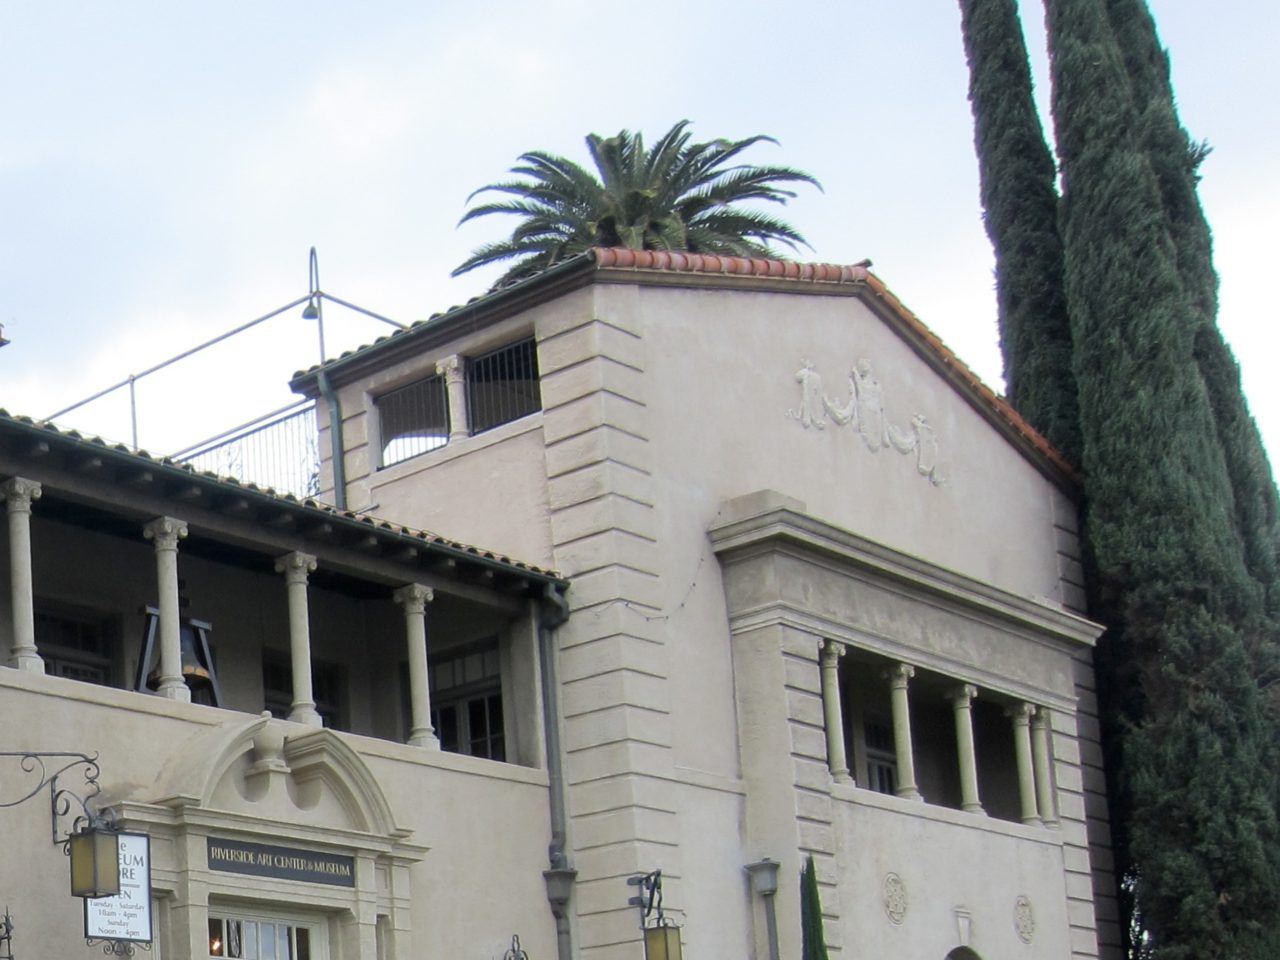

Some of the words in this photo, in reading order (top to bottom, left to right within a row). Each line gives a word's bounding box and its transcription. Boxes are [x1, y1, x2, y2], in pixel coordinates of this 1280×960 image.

[211, 847, 255, 864] RIVERSIDE
[257, 853, 272, 867] ART
[274, 855, 306, 870] CENTER
[307, 862, 313, 870] &
[314, 861, 351, 876] MUSEUM
[90, 901, 113, 910] Tuesday
[119, 903, 145, 912] Saturday
[99, 909, 117, 917] 10am
[123, 911, 138, 919] 4pm
[107, 920, 129, 928] Sunday
[98, 927, 117, 935] Noon
[126, 929, 140, 938] 4pm
